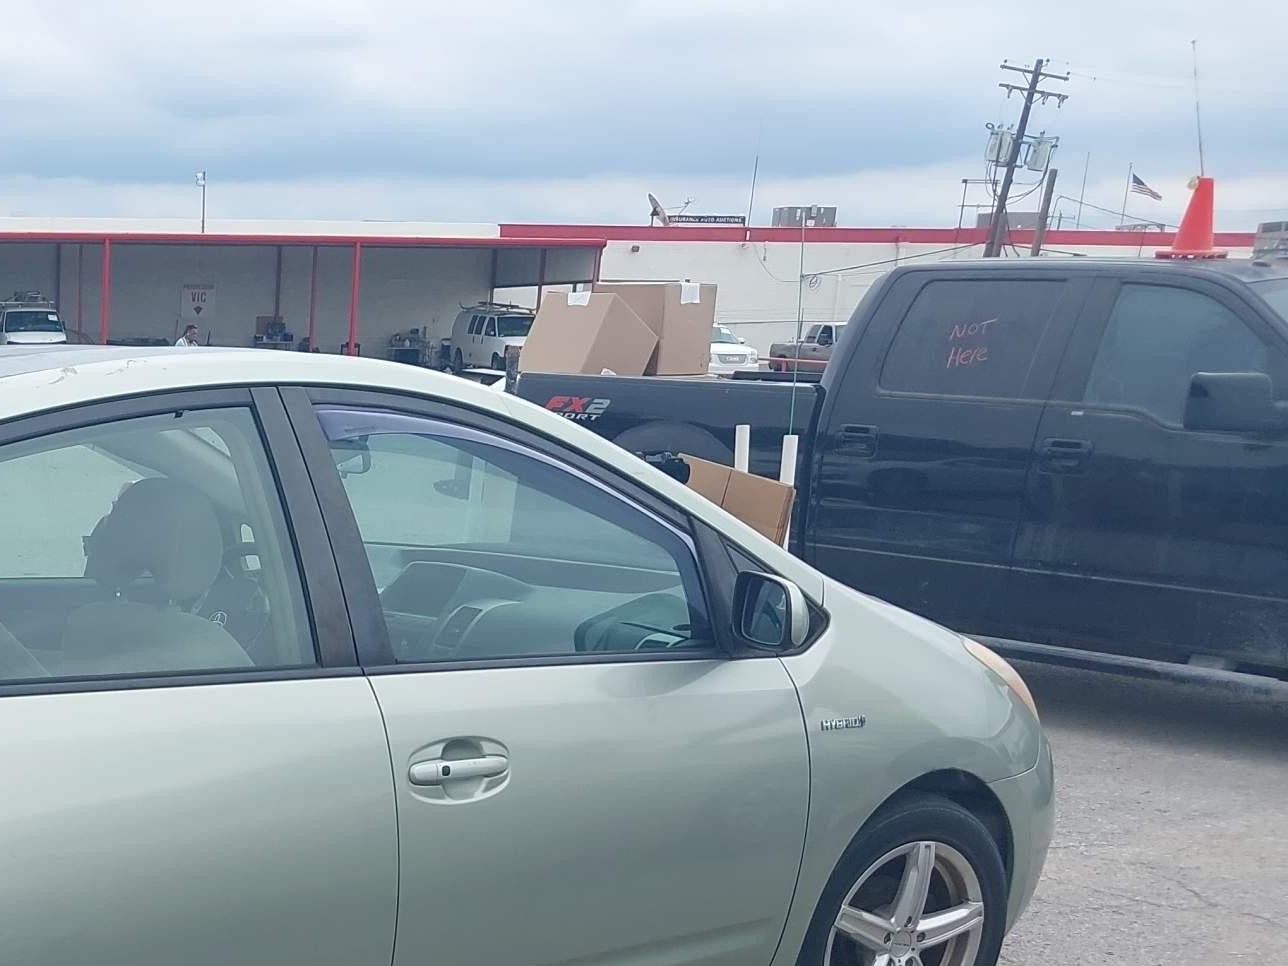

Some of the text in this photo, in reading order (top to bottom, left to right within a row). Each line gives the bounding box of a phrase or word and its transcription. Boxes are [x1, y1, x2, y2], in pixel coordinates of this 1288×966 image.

[192, 291, 207, 303] VIC
[949, 317, 999, 340] NOT
[545, 395, 611, 414] FX2
